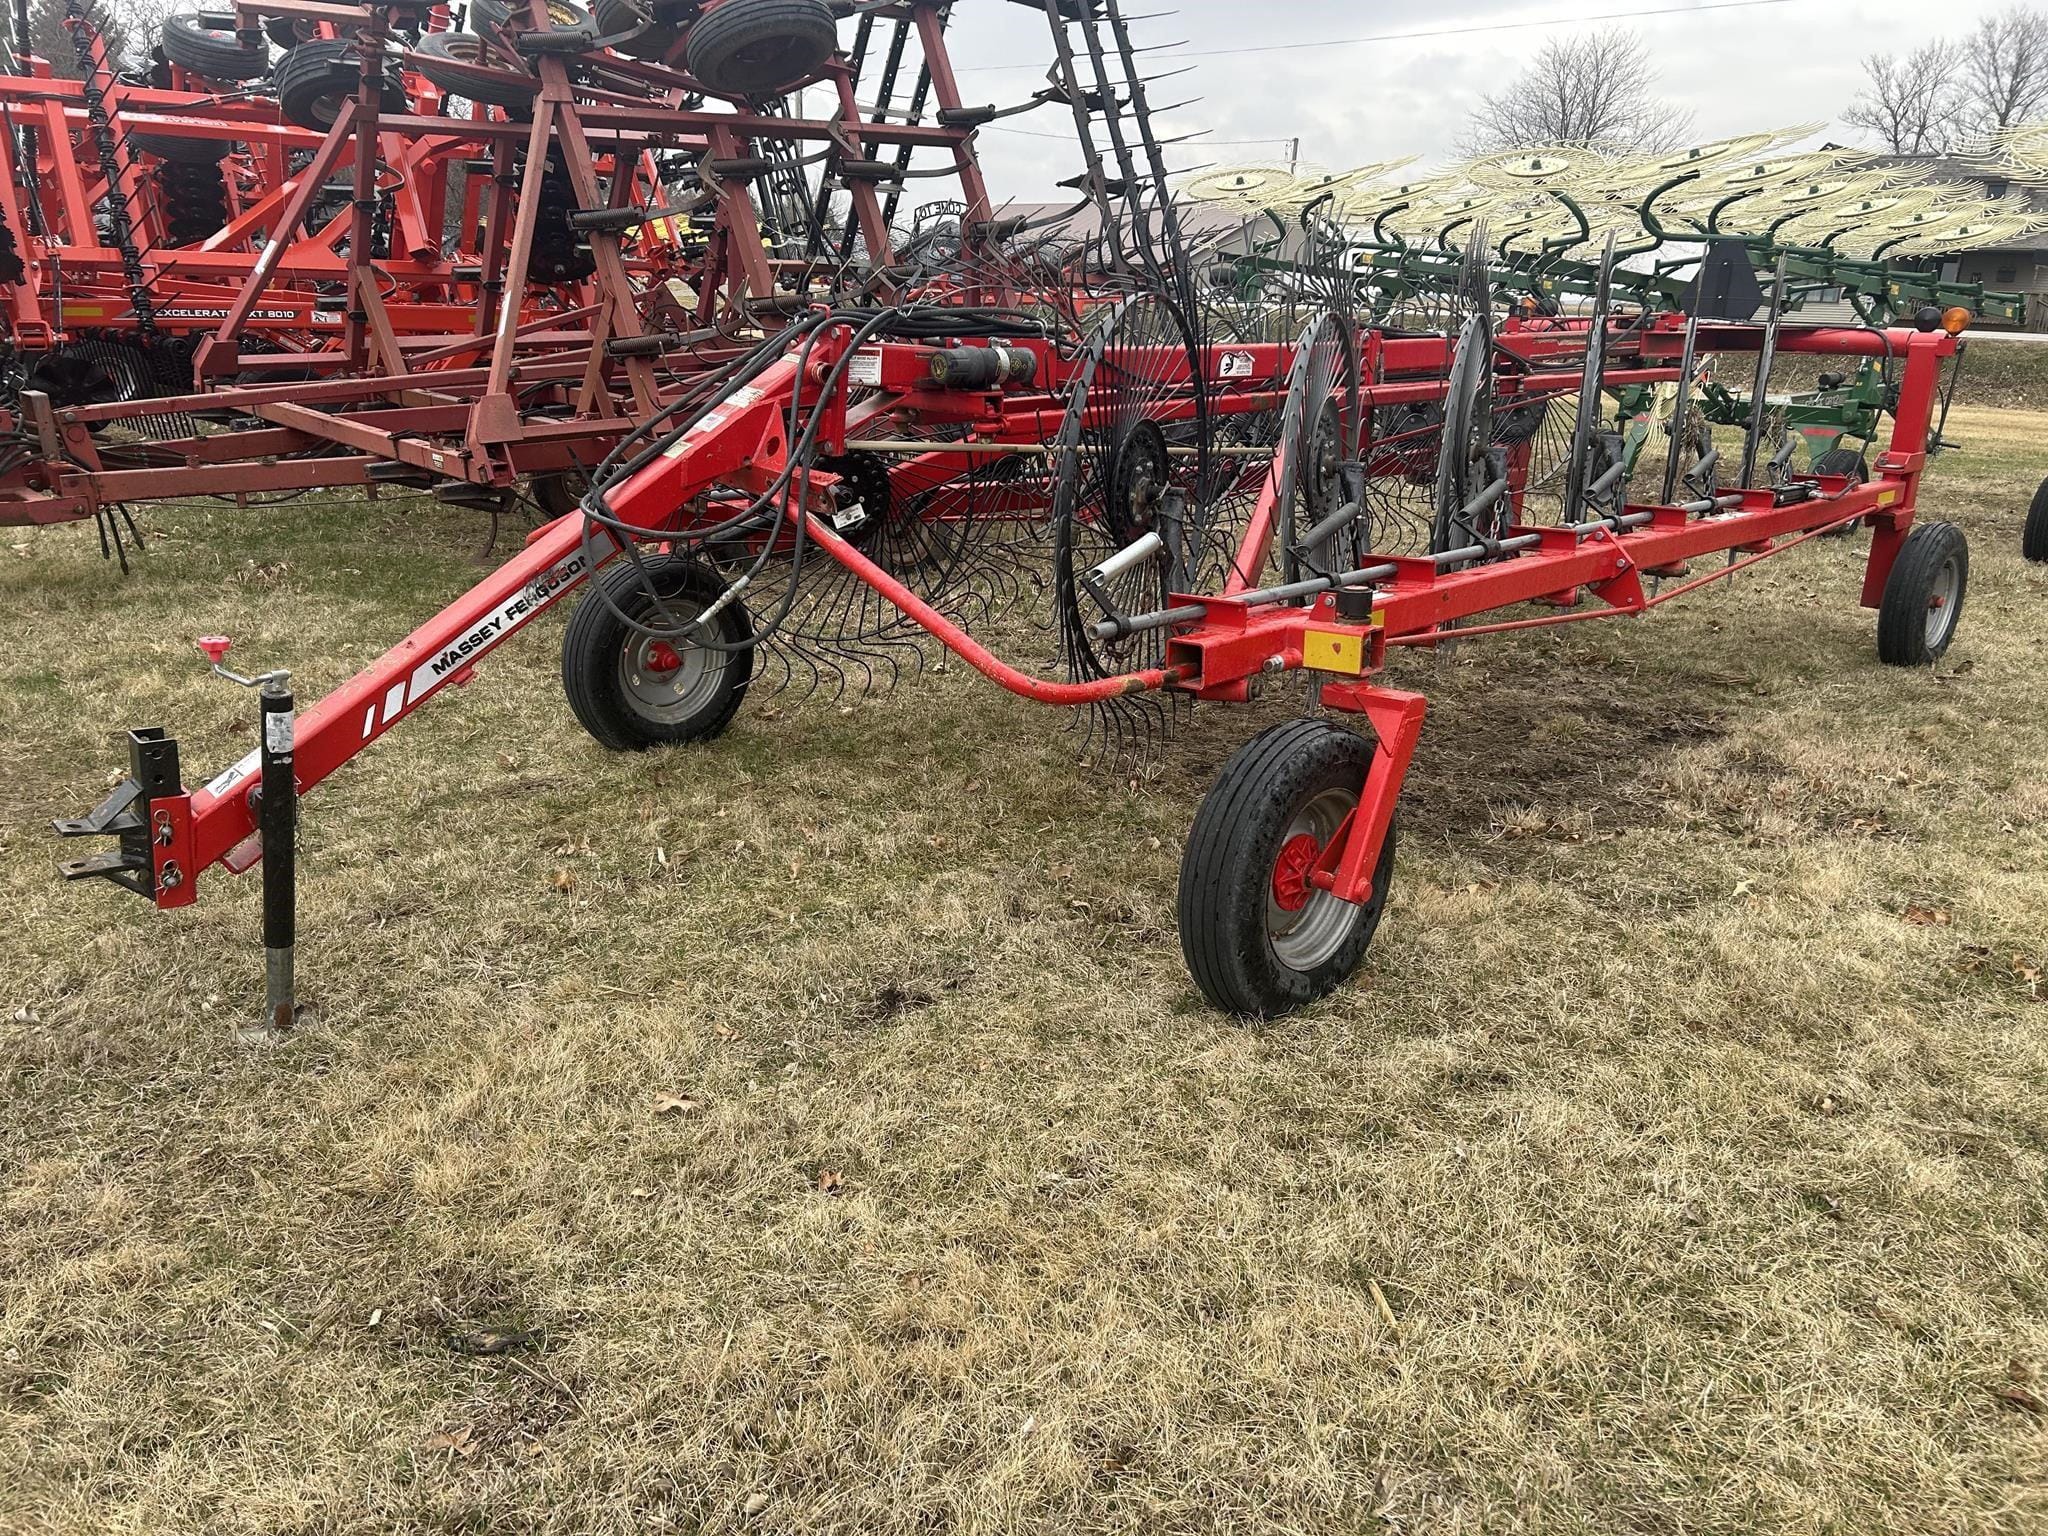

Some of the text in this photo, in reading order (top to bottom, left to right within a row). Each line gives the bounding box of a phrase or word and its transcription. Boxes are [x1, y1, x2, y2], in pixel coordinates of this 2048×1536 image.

[155, 309, 294, 318] EXCELERAT XT 8010
[431, 616, 502, 676] MASSEY
